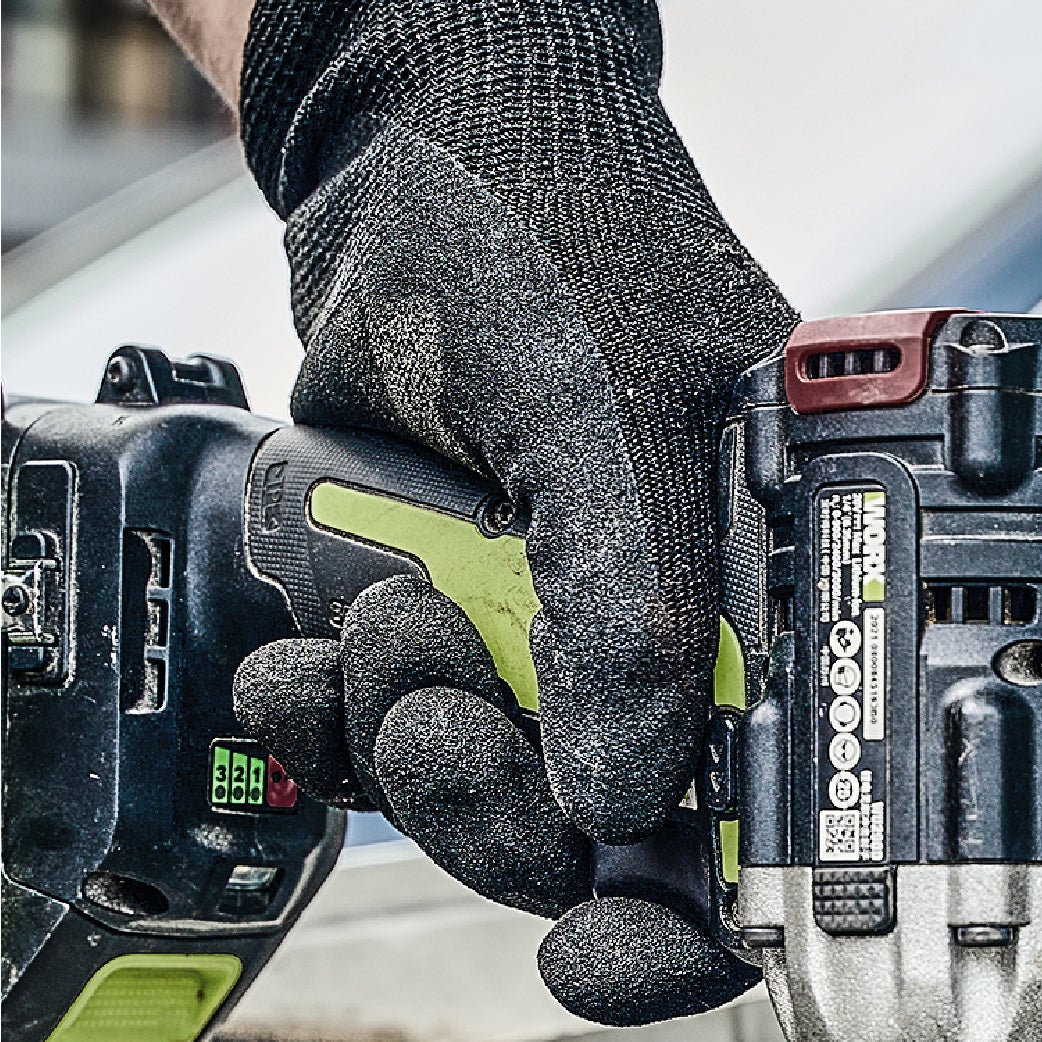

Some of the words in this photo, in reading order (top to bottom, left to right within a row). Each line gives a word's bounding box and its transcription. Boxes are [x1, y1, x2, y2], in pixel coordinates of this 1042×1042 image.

[863, 495, 885, 585] WORX
[216, 765, 227, 782] 3
[233, 766, 245, 782] 2
[252, 766, 260, 783] 1
